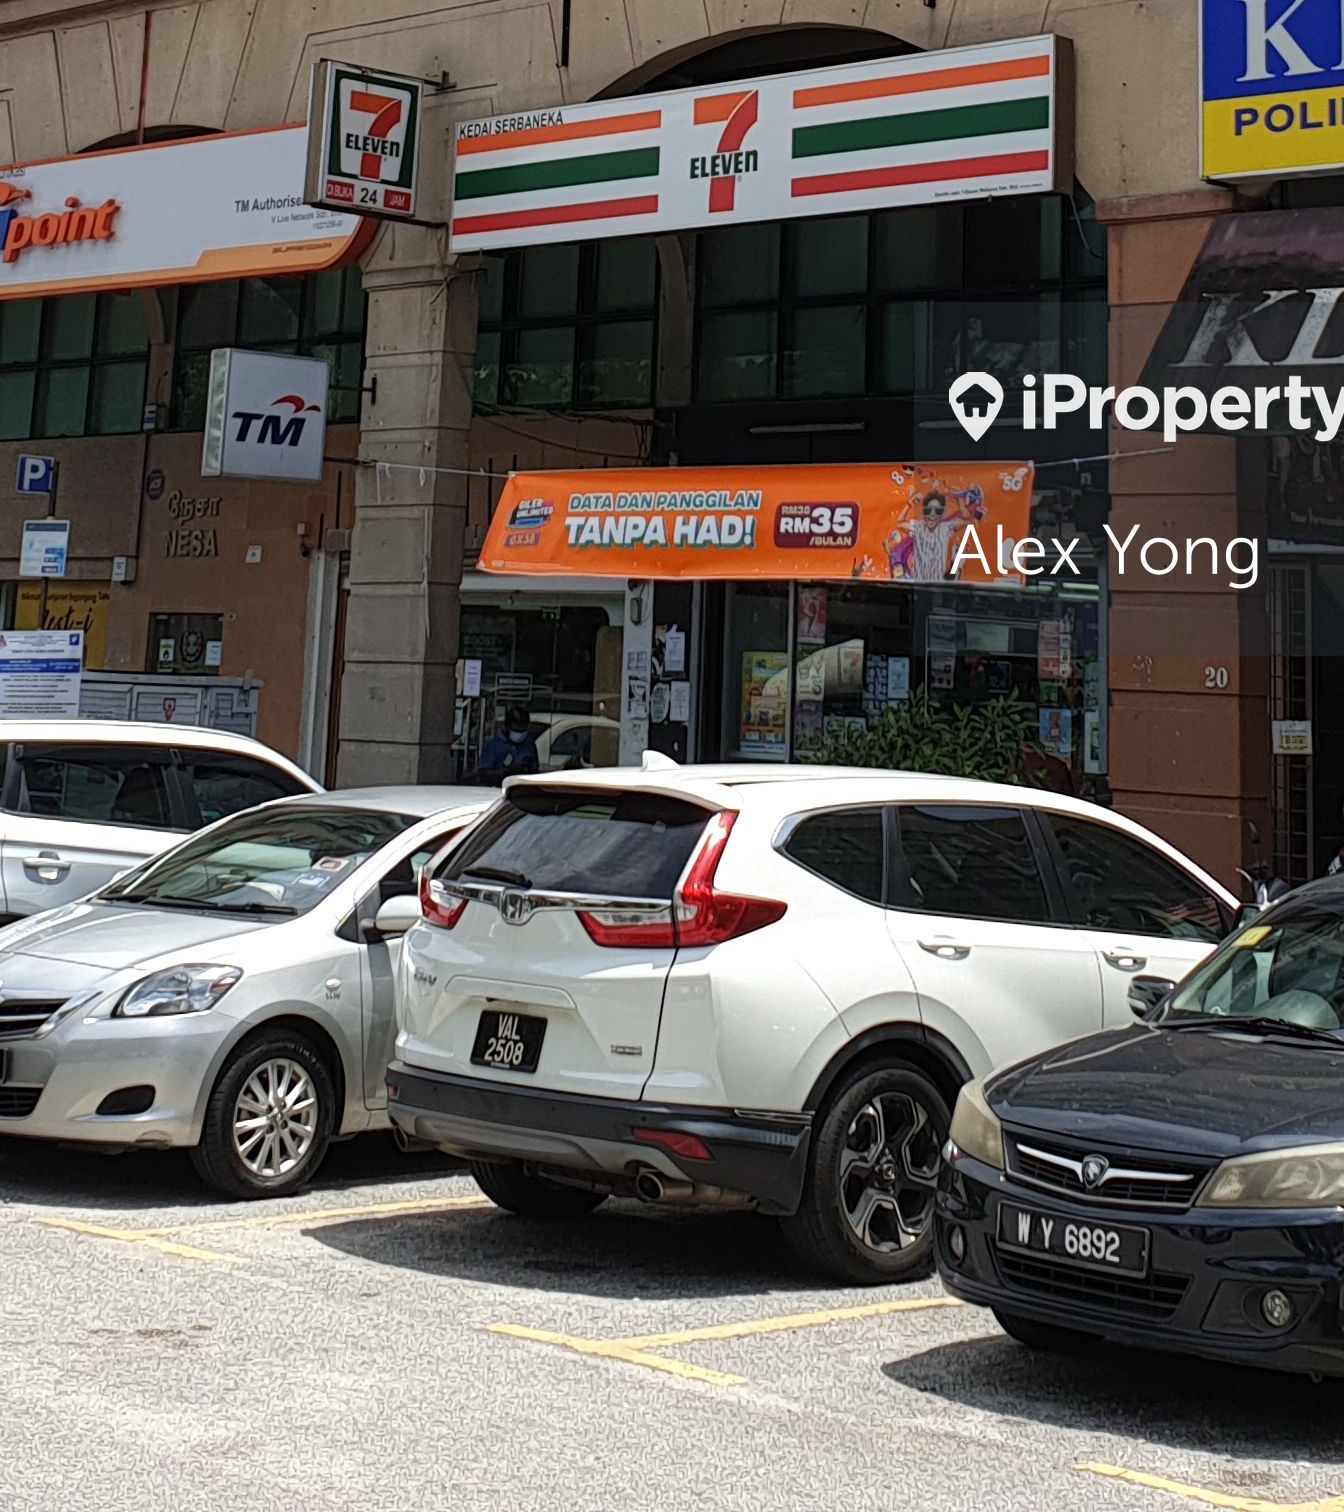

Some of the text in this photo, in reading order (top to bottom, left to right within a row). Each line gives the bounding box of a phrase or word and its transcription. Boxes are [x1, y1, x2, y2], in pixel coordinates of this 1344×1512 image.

[458, 112, 564, 139] KEDAI SERBANEKA
[235, 194, 305, 213] TM Authorise
[360, 188, 405, 206] 24 JAM
[231, 411, 306, 447] TM
[23, 458, 46, 491] P
[569, 490, 761, 511] DATA DAN PANGGILAN
[164, 529, 218, 558] NESA
[565, 513, 756, 549] TANPA HAD!
[1204, 666, 1229, 689] 20
[498, 1014, 521, 1040] VAL
[483, 1038, 524, 1065] 2508
[1017, 1213, 1121, 1262] W Y 6892
